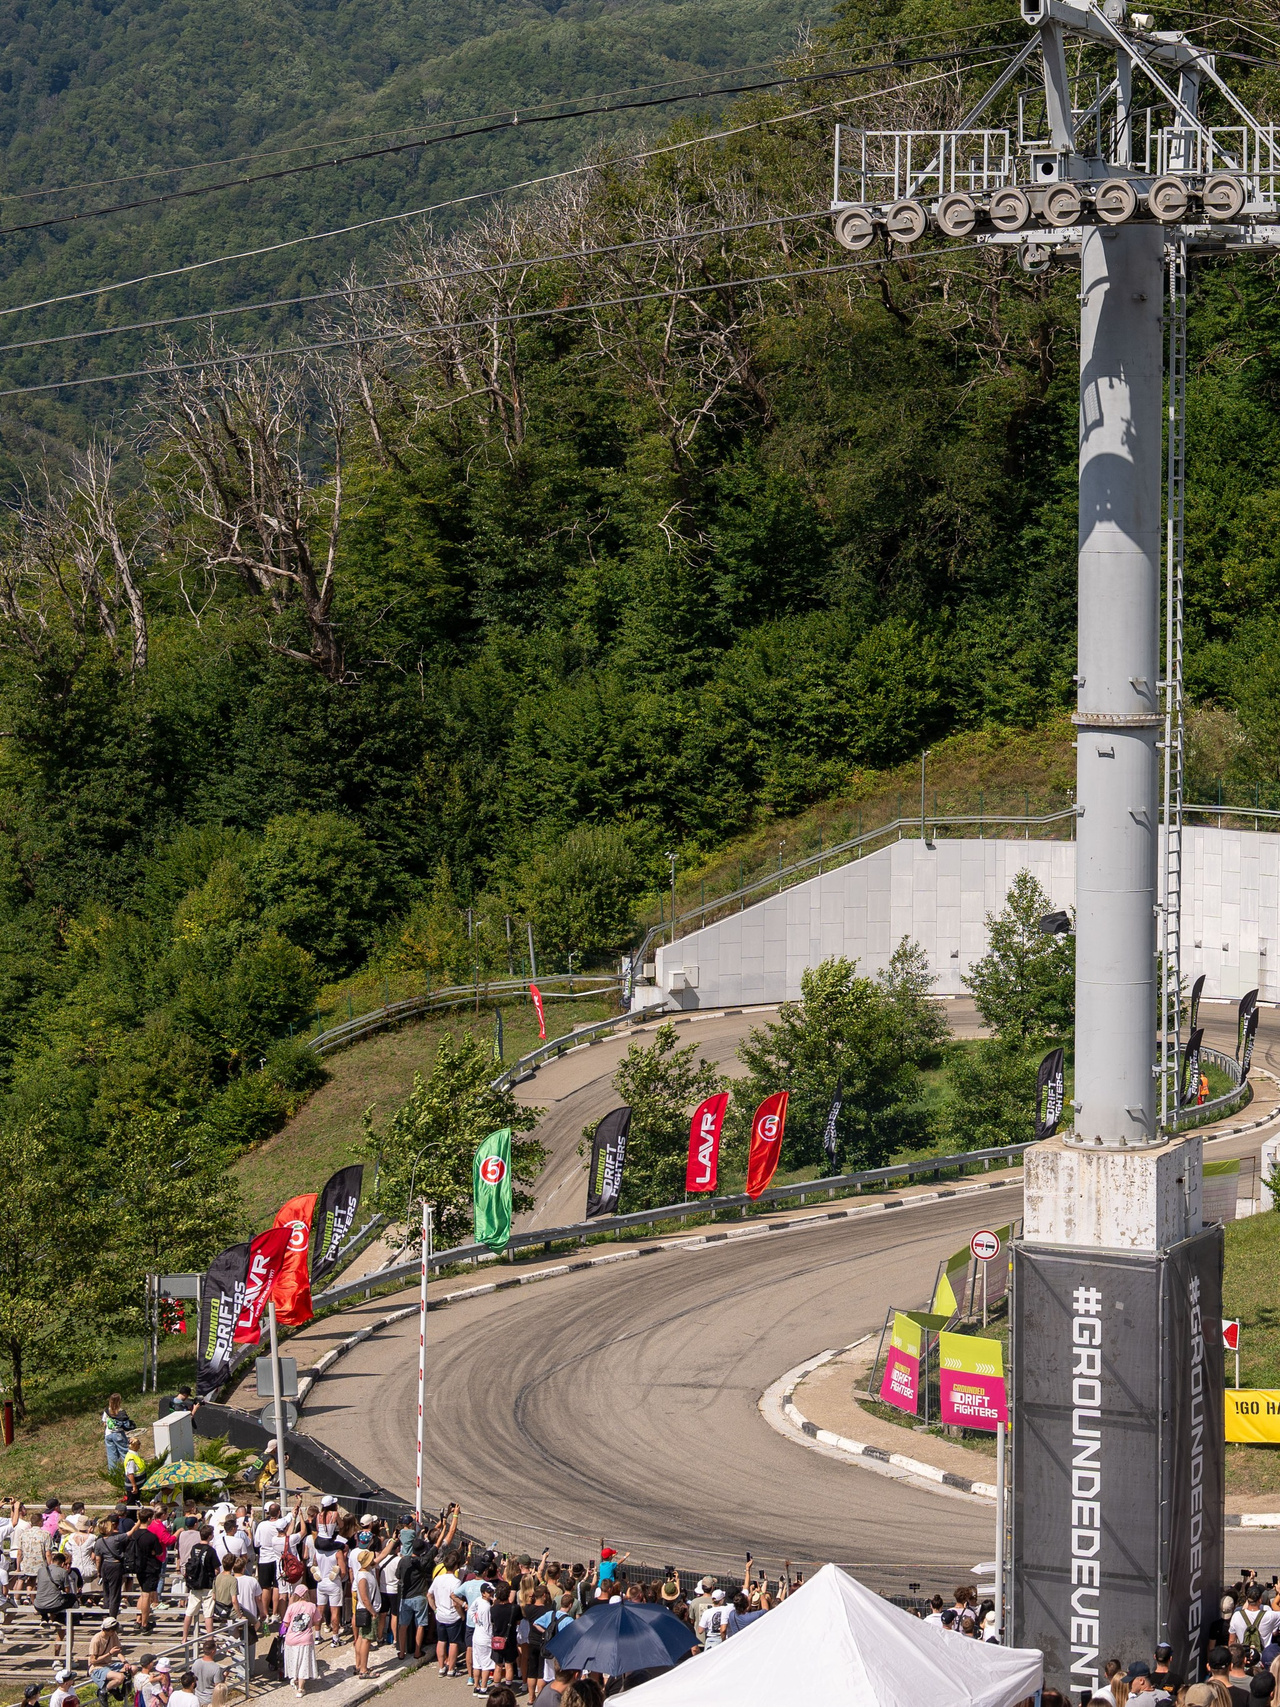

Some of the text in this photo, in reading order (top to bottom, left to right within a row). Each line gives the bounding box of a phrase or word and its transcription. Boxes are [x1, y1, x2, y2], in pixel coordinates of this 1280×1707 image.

[1046, 1080, 1057, 1125] DRIFT
[595, 1148, 606, 1195] GROUNDED
[602, 1143, 617, 1197] DRIFT
[610, 1135, 626, 1197] FIGHTERS
[695, 1113, 717, 1184] LAVR
[238, 1254, 271, 1328] LAVR
[205, 1298, 220, 1361] GROUNDED
[213, 1291, 234, 1358] DRIFT
[890, 1380, 914, 1399] FIGHTERS
[892, 1369, 912, 1387] DRIFT
[952, 1383, 986, 1395] GROUNDED
[954, 1391, 990, 1408] DRIFT
[953, 1403, 998, 1419] FIGHTERS
[1235, 1401, 1260, 1416] !GO
